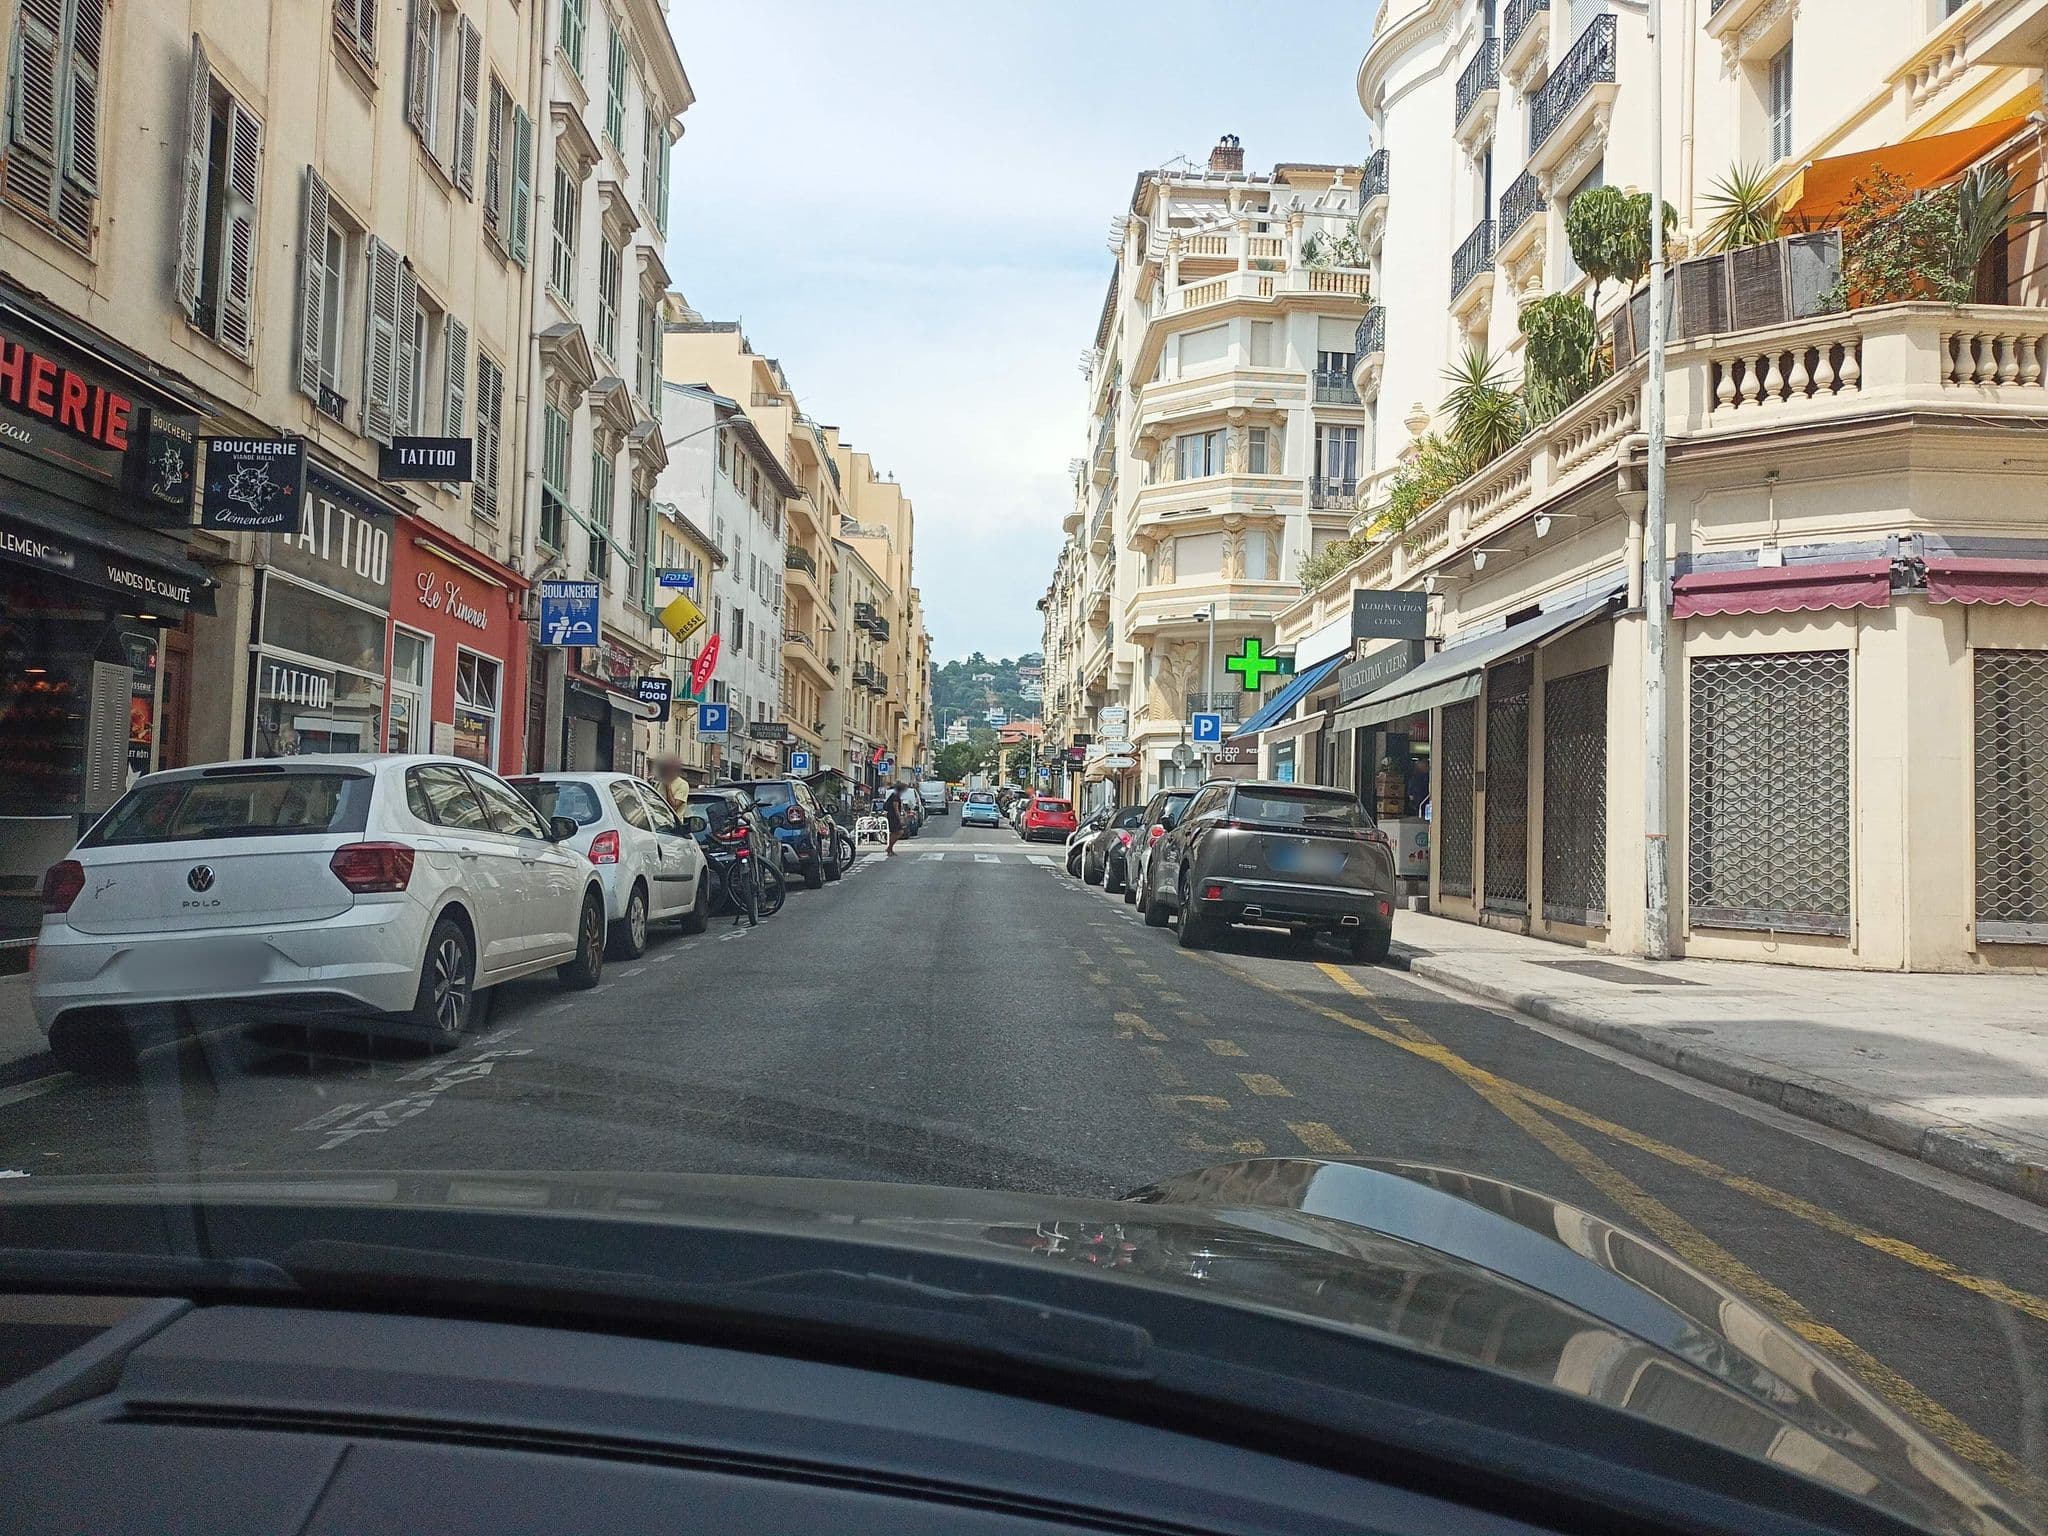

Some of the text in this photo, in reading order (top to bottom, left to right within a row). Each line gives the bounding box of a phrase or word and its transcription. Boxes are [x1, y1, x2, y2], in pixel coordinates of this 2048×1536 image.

[152, 415, 192, 444] BOUCHERIE
[212, 440, 297, 455] BOUCHERIE
[398, 447, 456, 466] TATTOO
[283, 491, 388, 586] ATTOO
[107, 566, 191, 603] VIANDES DE QUALITÉ
[417, 572, 442, 609] Le
[542, 584, 598, 599] BOULANGERIE
[1360, 602, 1422, 612] ALIMENTATION
[676, 614, 702, 639] PRESSE
[697, 646, 716, 683] TABAC
[269, 665, 328, 709] TATTOO
[641, 681, 667, 690] FAST
[640, 691, 667, 701] FOOD
[706, 708, 719, 726] P
[1200, 719, 1213, 737] P
[182, 899, 221, 908] POLO
